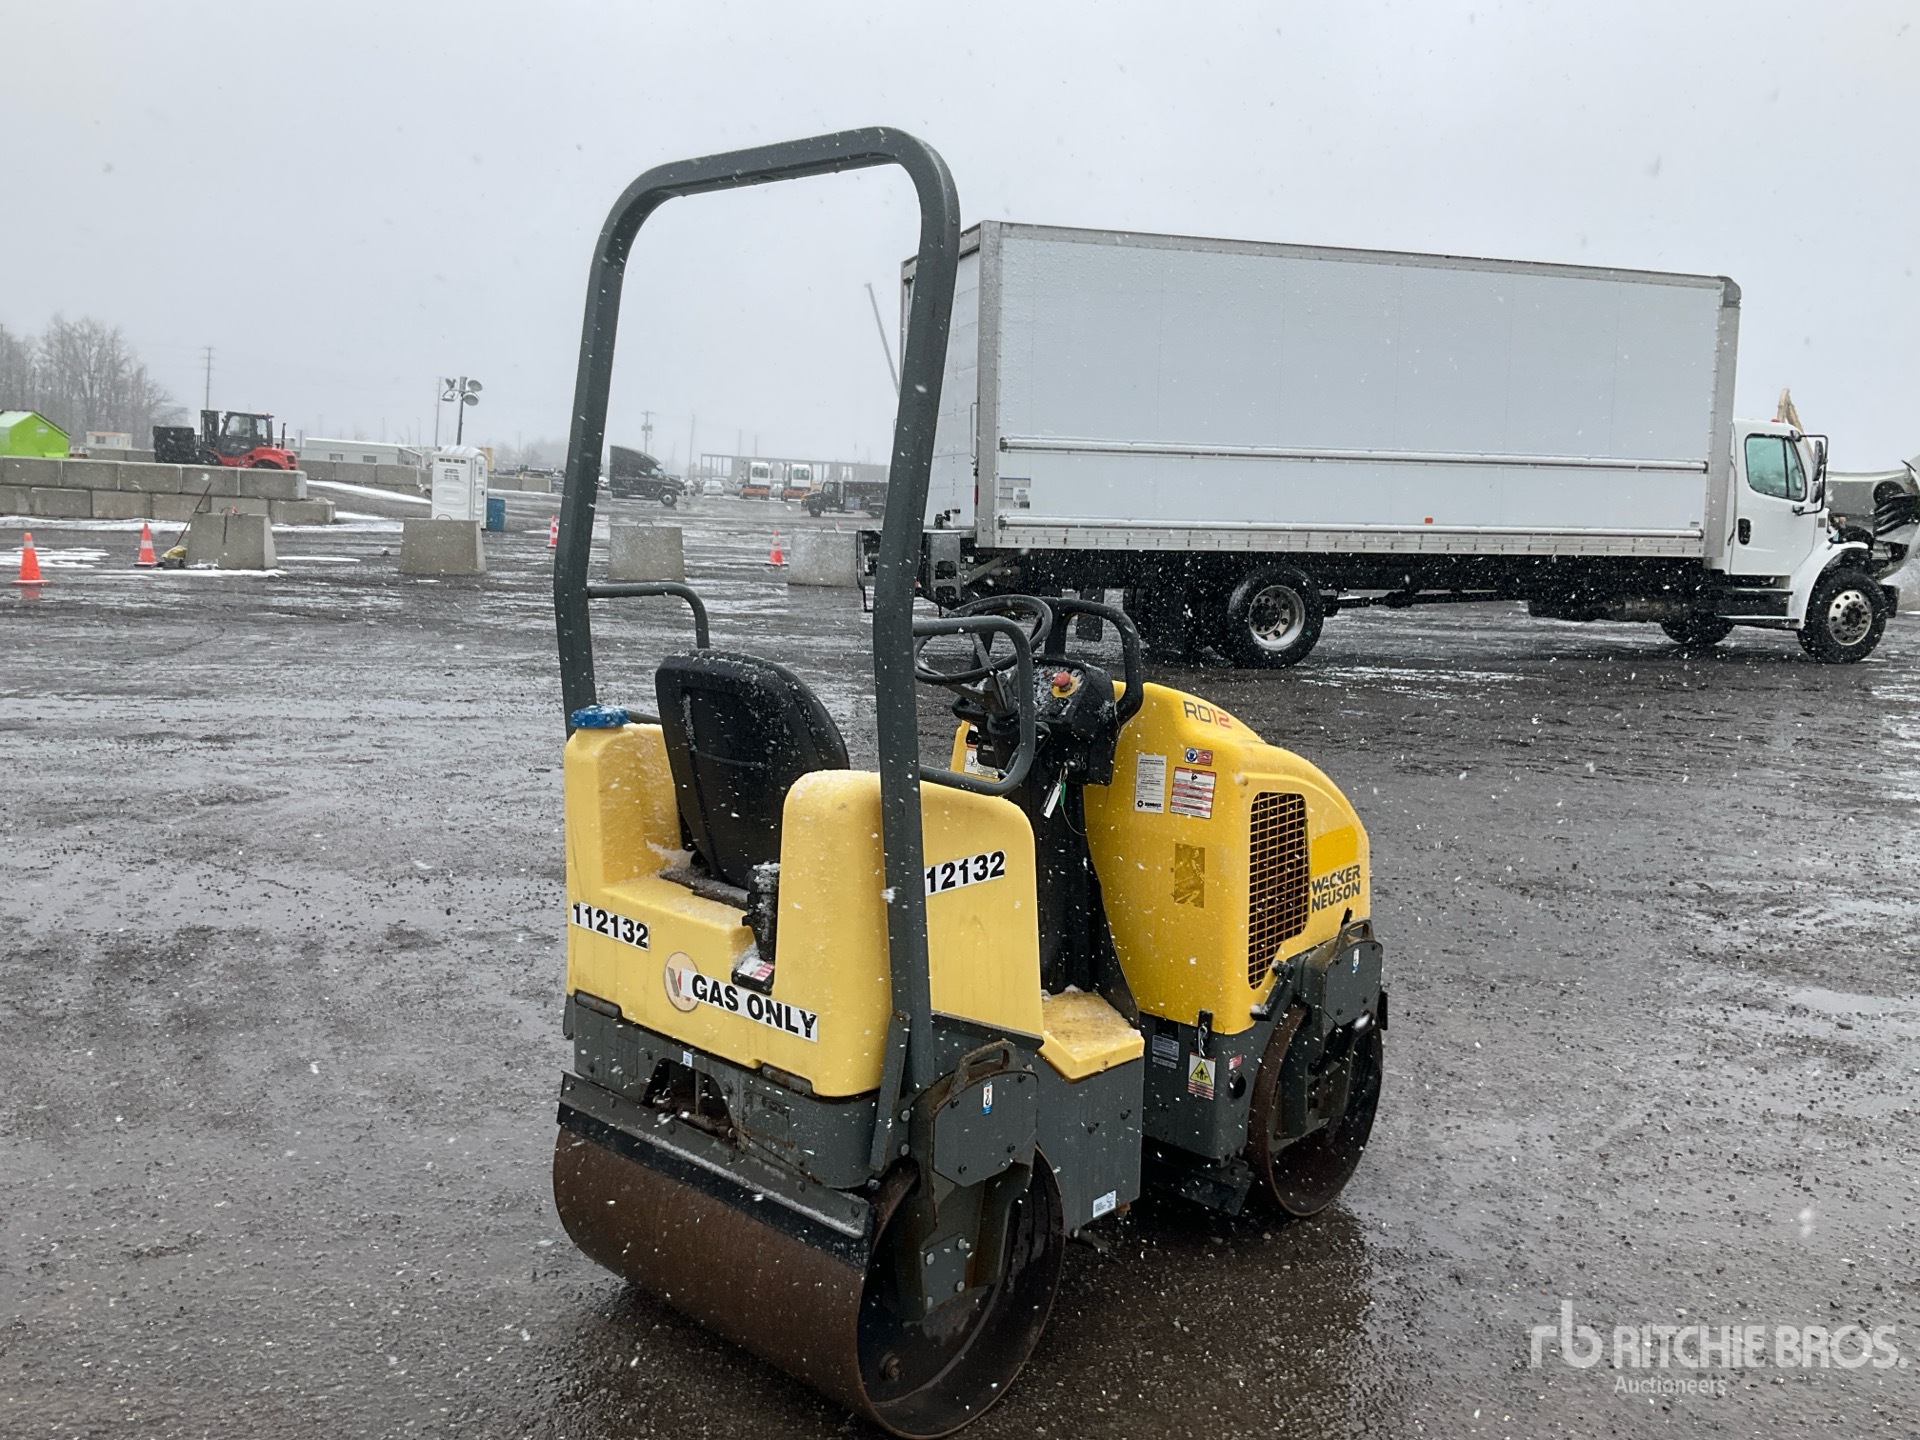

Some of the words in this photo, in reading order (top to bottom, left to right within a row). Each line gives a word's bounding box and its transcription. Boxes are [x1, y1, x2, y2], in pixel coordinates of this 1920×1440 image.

[1183, 700, 1232, 729] RD12
[1311, 864, 1361, 895] WACKER
[1311, 879, 1361, 913] NEUSON
[572, 902, 649, 949] 112132
[691, 973, 739, 1013] GAS
[746, 993, 817, 1039] ONLY
